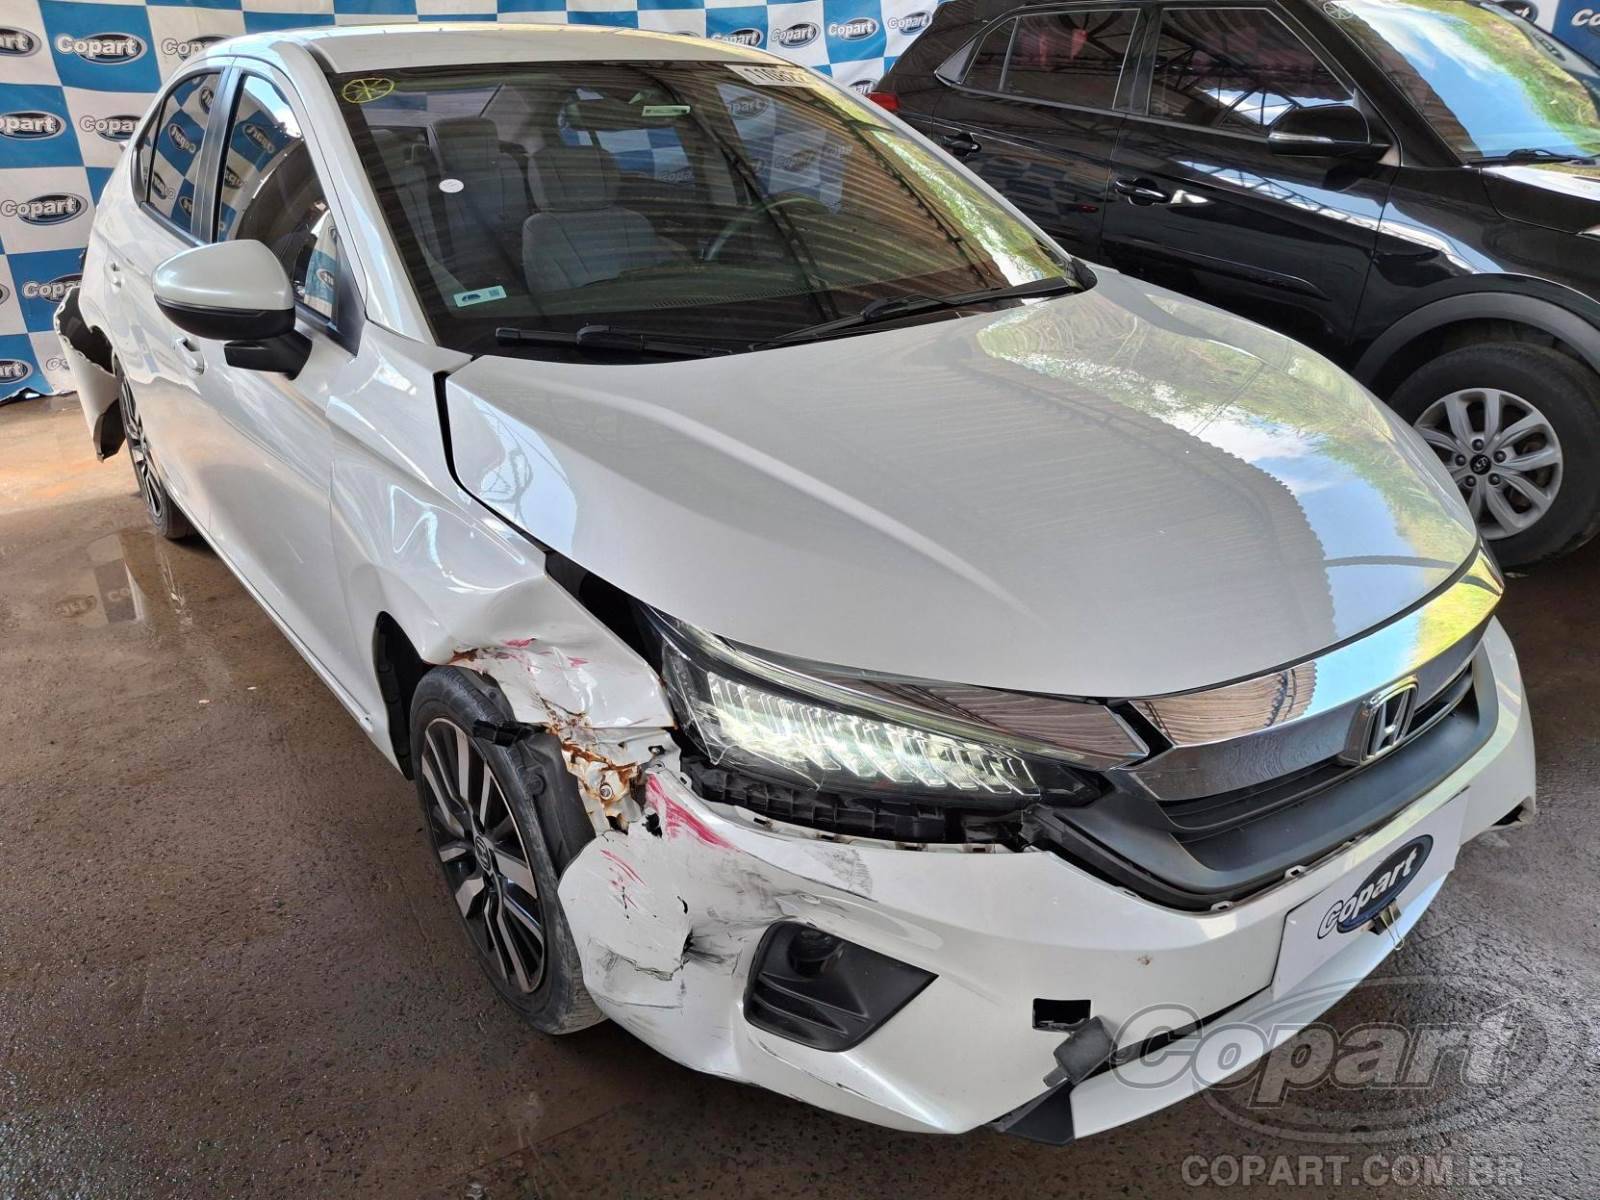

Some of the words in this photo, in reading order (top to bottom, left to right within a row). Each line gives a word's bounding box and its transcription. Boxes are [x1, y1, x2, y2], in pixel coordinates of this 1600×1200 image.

[828, 21, 872, 37] Copart
[888, 15, 925, 30] Copart
[772, 27, 813, 44] Copart
[56, 35, 138, 59] Copart
[0, 115, 56, 135] part
[80, 115, 135, 135] Copa
[0, 197, 77, 220] Copart
[1318, 847, 1418, 939] Copart
